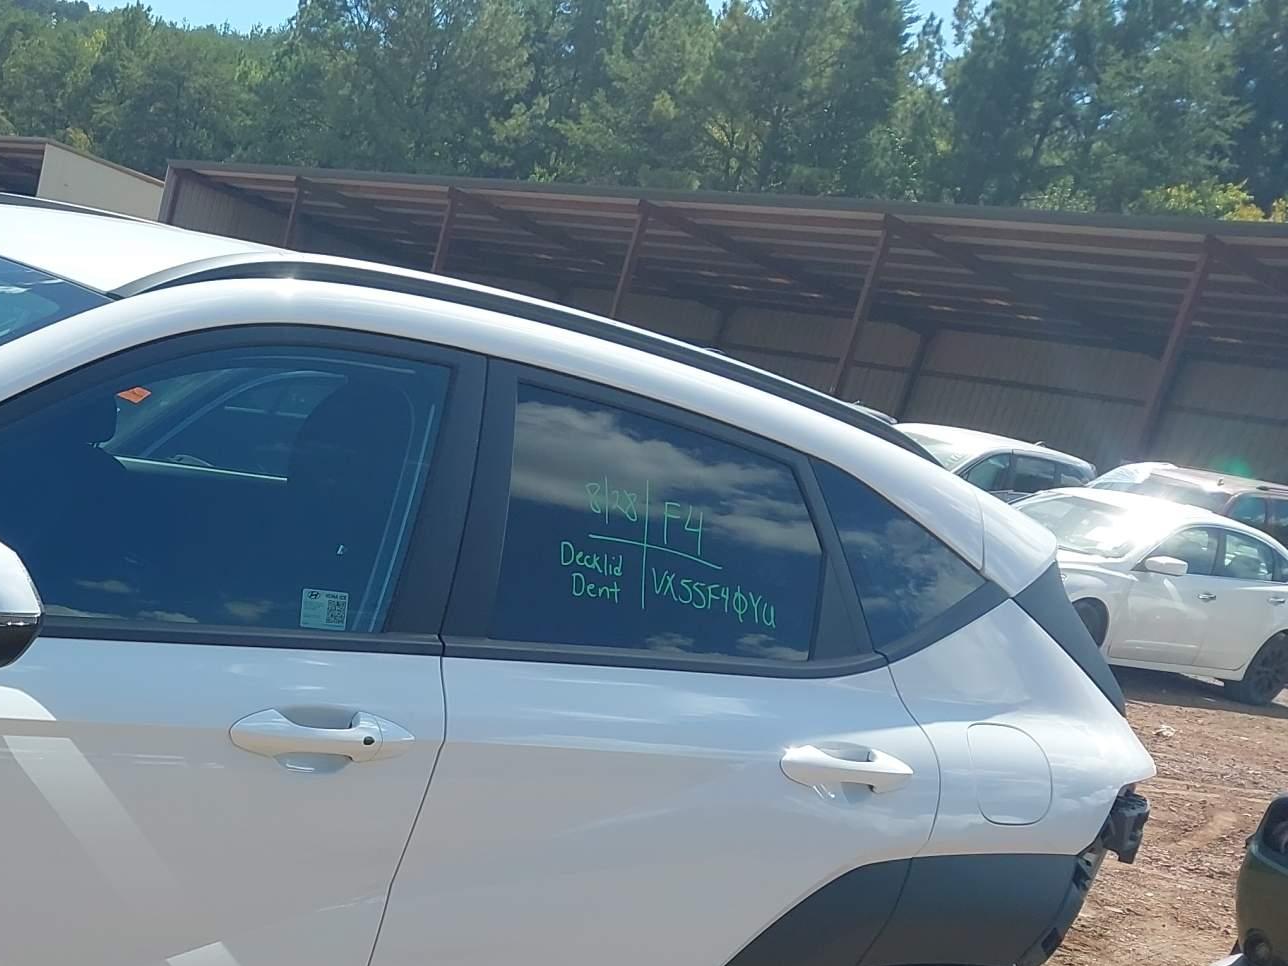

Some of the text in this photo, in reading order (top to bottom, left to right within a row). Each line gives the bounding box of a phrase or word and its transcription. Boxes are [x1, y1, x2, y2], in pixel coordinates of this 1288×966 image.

[663, 501, 704, 556] F4
[561, 541, 623, 577] Decklid
[572, 572, 621, 604] Dent
